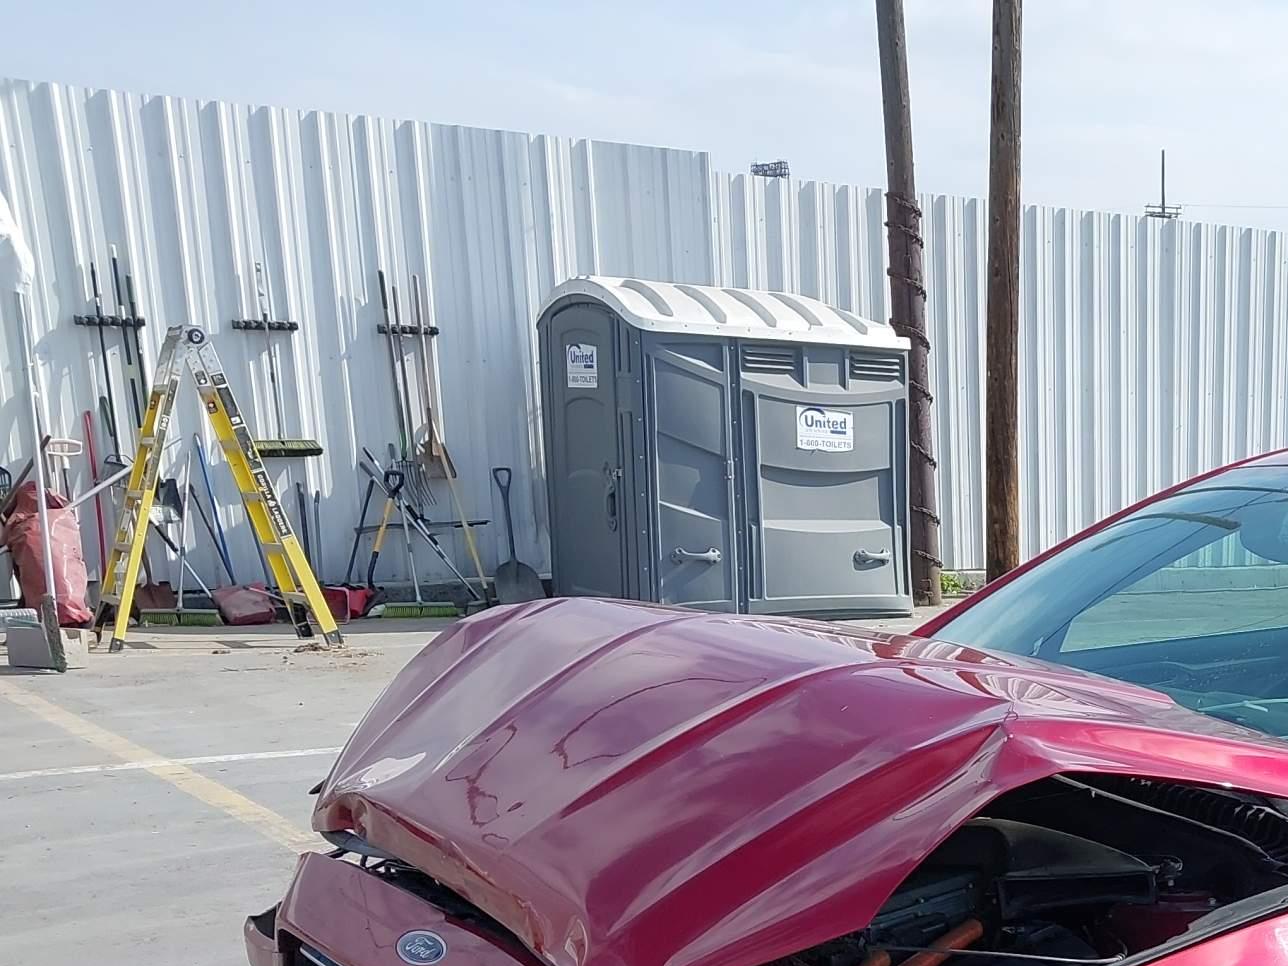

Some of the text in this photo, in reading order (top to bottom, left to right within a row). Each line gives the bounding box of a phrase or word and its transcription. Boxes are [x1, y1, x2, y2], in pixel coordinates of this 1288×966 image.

[570, 350, 594, 364] United
[804, 414, 847, 430] United
[406, 936, 436, 959] Ford
